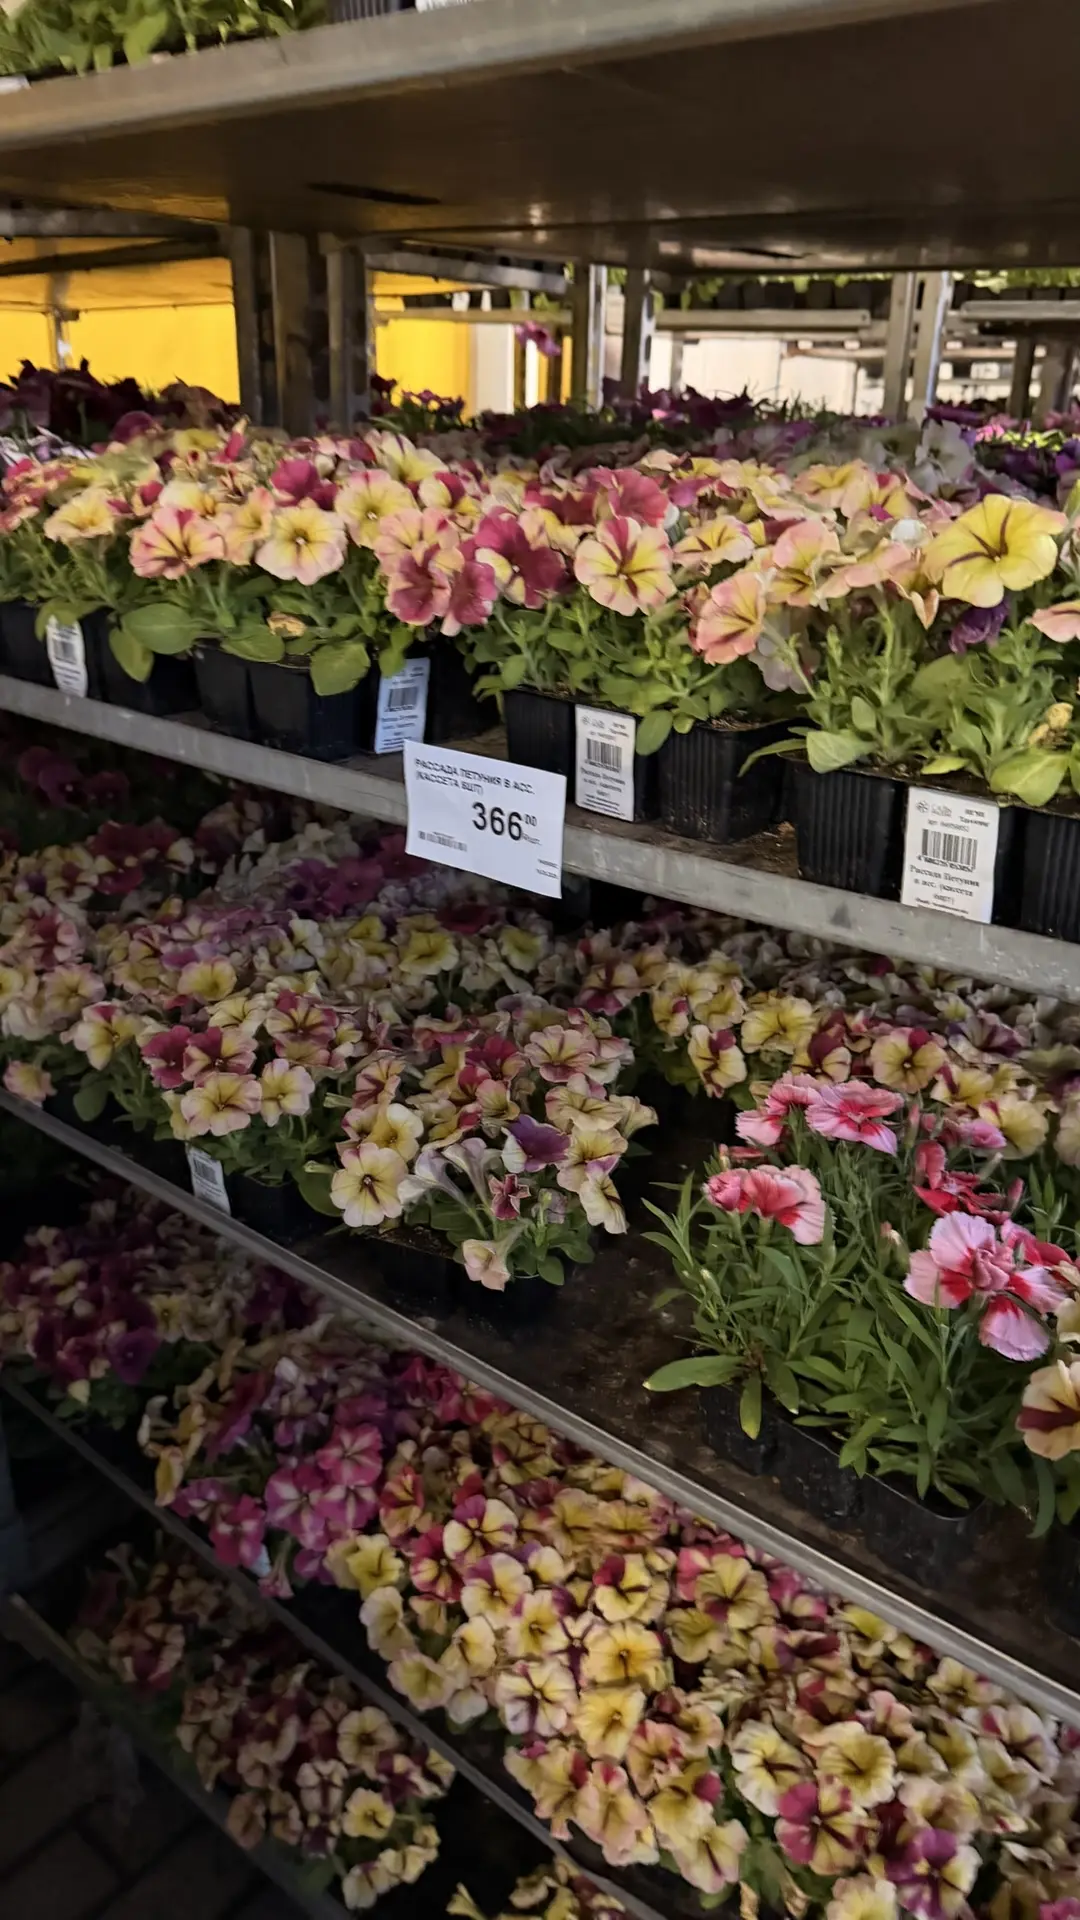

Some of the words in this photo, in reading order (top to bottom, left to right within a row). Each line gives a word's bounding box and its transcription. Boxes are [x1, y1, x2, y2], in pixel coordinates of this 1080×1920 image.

[414, 757, 459, 776] РАССАДА
[459, 767, 502, 786] ПЕТУНИЯ
[503, 778, 511, 789] В
[472, 801, 523, 841] 366
